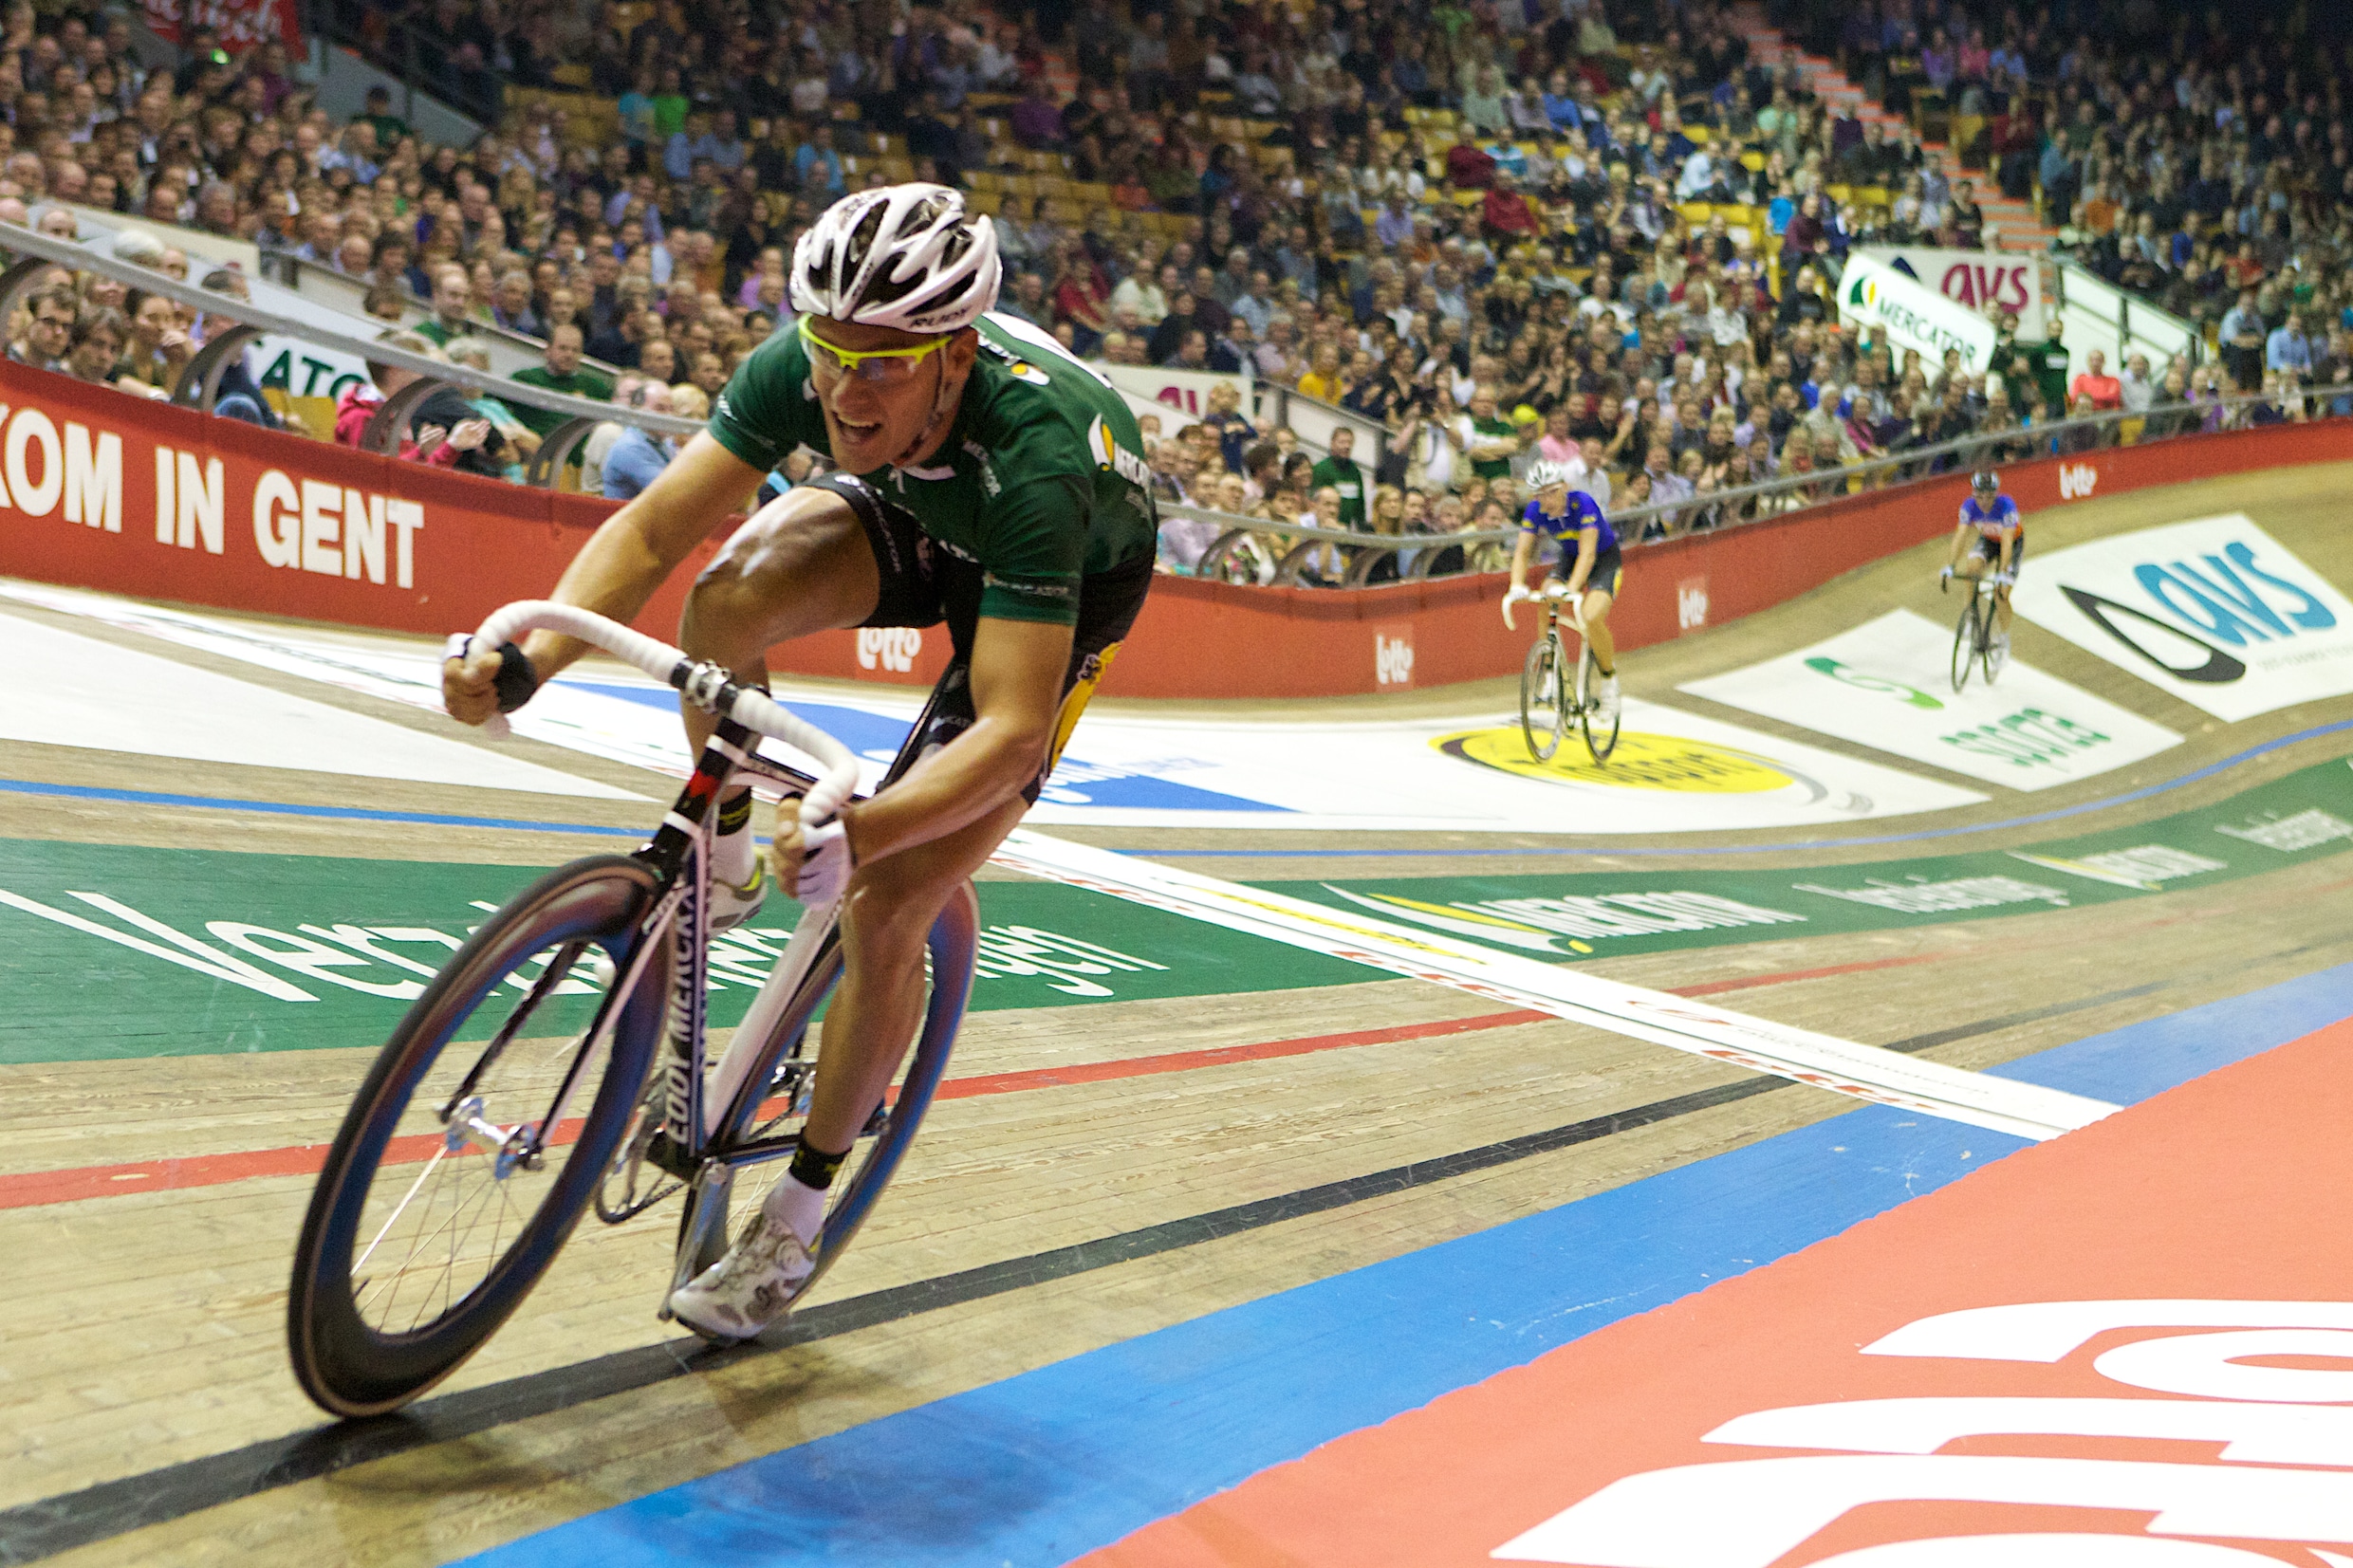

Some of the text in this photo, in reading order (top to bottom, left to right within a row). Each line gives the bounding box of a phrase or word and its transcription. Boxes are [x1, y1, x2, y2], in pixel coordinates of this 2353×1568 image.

[1940, 263, 2029, 314] avs
[1879, 297, 1976, 366] MERCATOR
[156, 445, 225, 555] IN
[252, 469, 424, 589] GENT
[857, 627, 922, 673] lotto
[1449, 891, 1808, 938] MERCATOR
